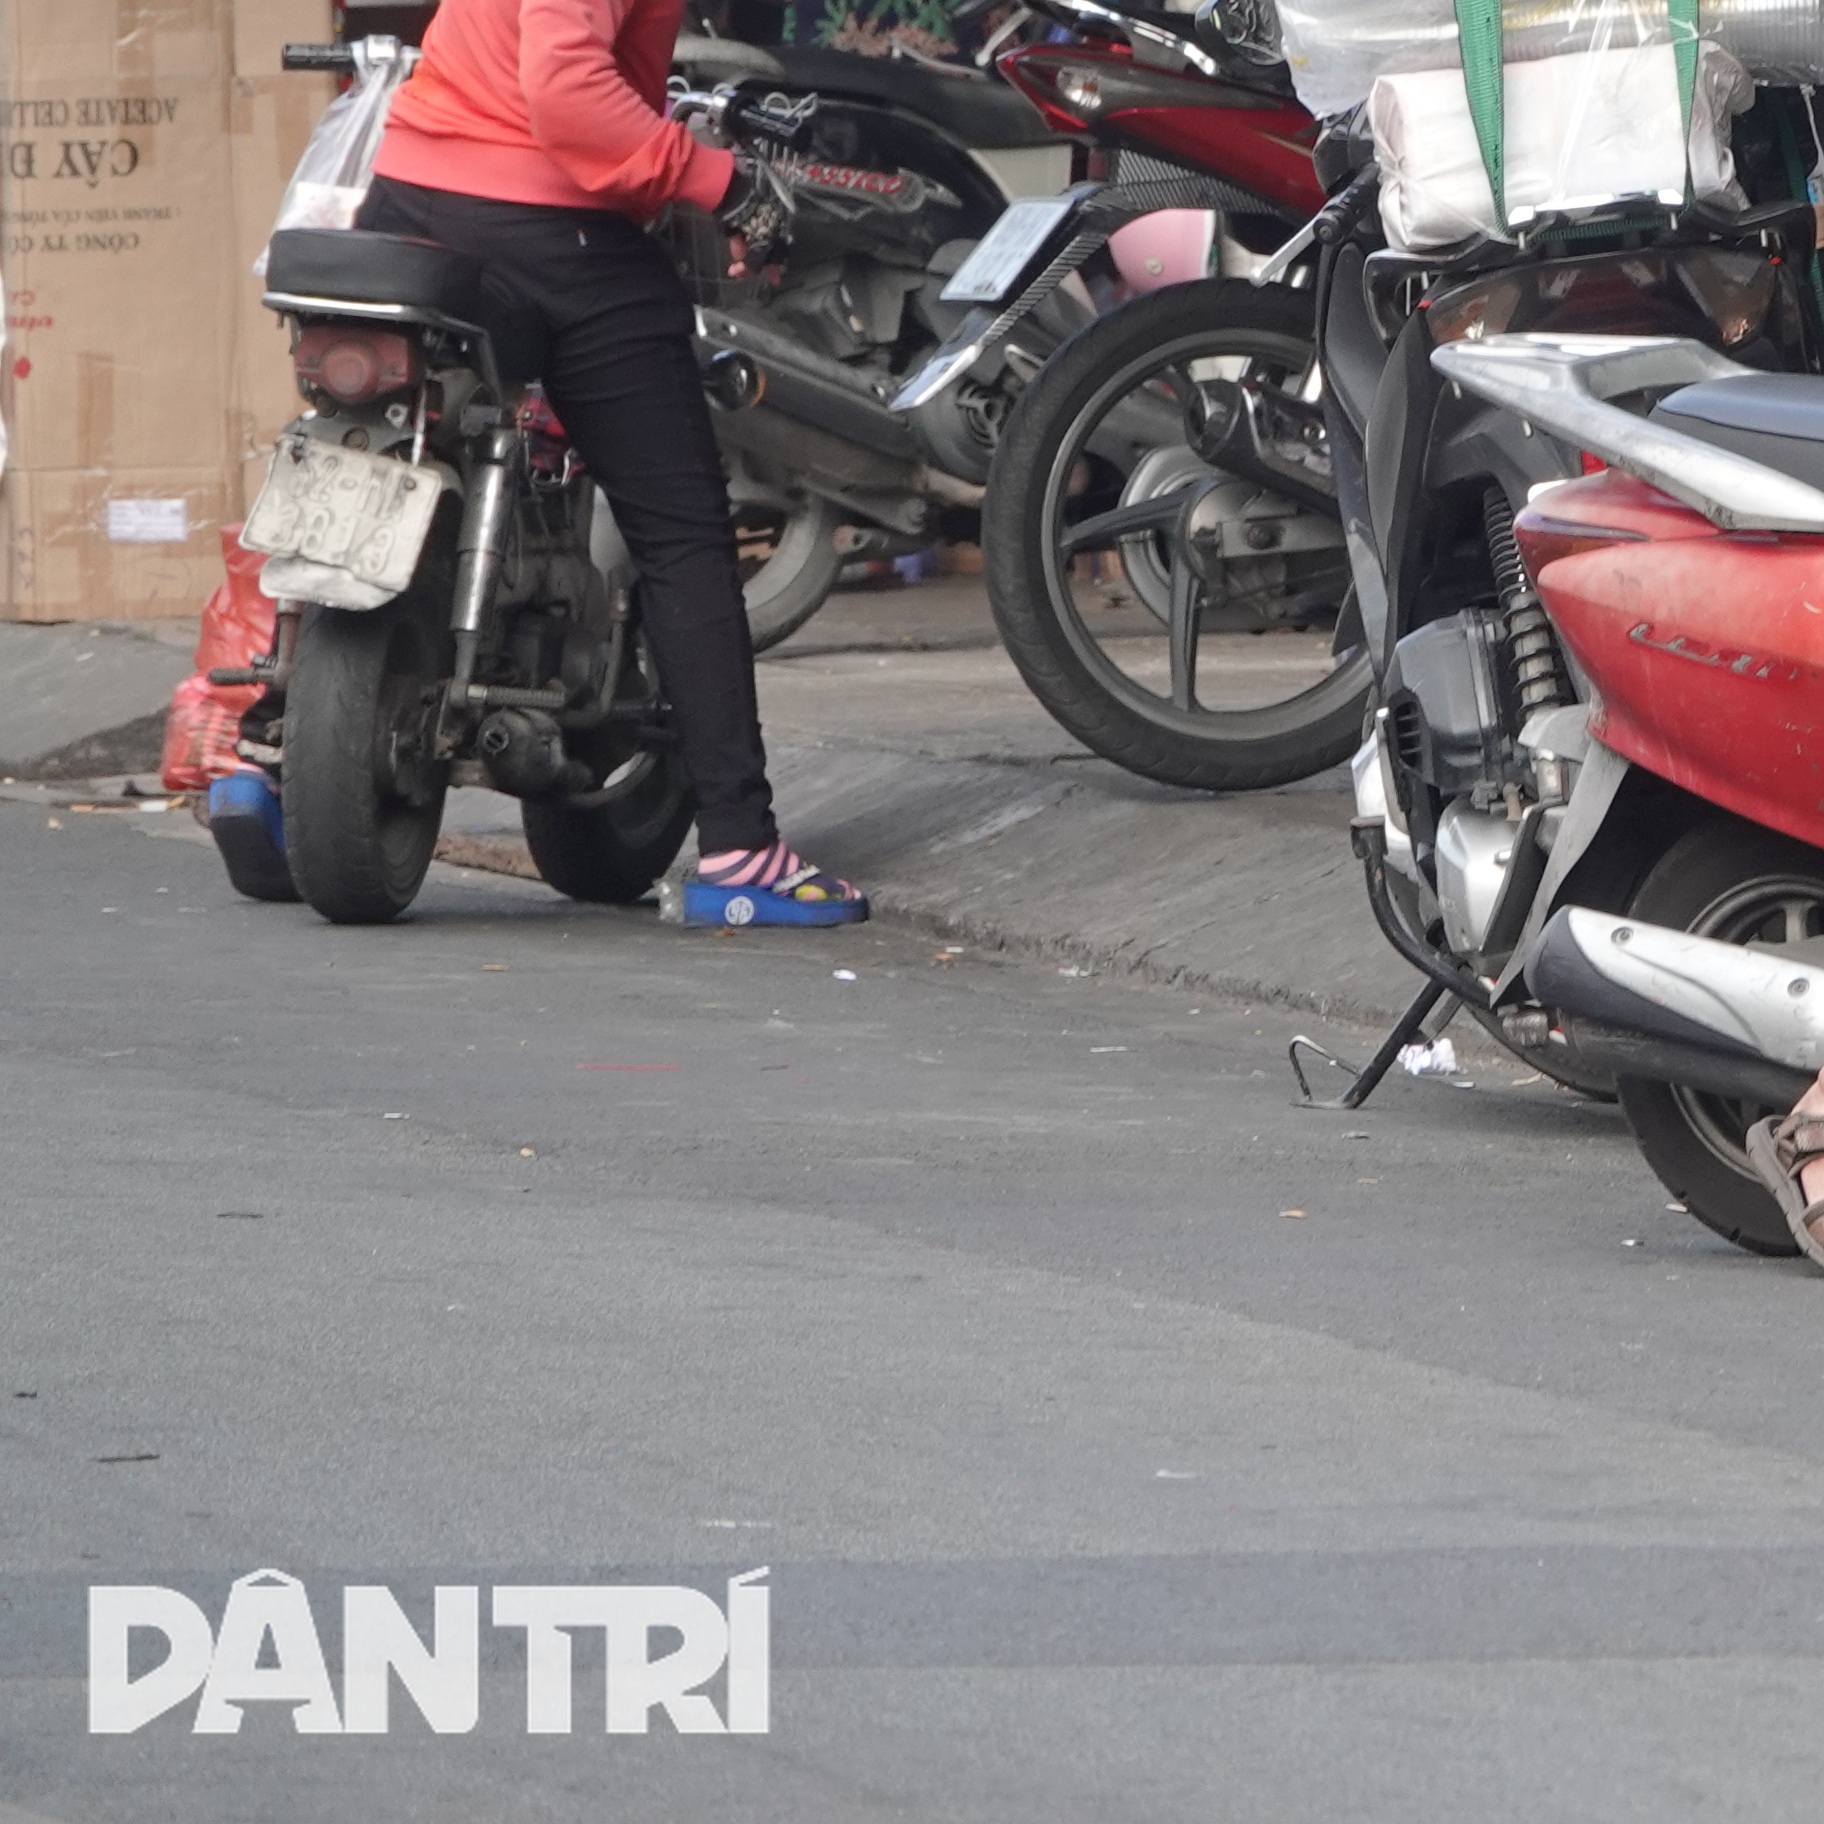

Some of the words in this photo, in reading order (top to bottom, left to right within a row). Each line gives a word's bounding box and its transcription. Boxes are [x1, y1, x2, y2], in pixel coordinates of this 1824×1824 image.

[75, 96, 178, 127] ACETATE
[53, 138, 139, 190] CÂY
[40, 234, 68, 252] TY
[74, 231, 140, 255] CÔNG
